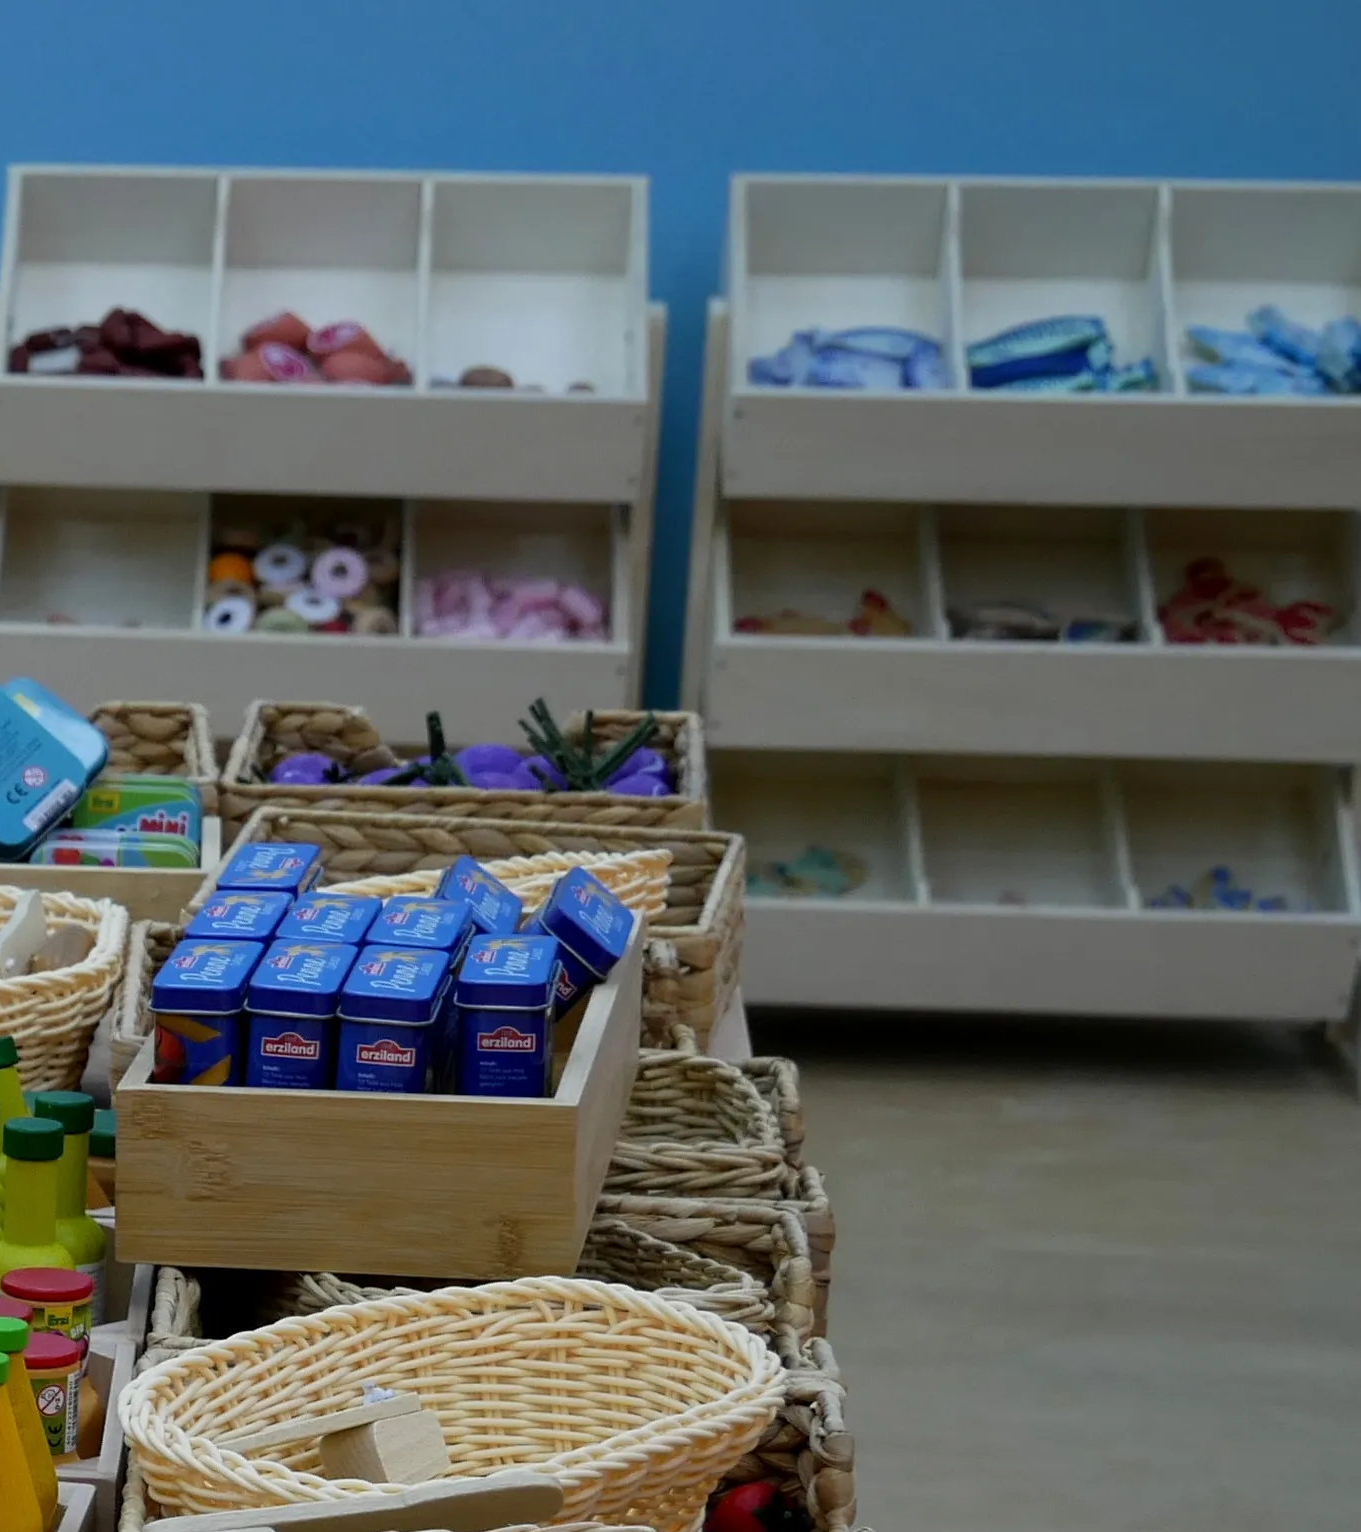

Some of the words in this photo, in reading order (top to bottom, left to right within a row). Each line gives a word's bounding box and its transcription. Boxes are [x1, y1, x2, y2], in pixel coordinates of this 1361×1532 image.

[211, 904, 262, 931] Penne
[301, 908, 352, 937] Penne
[394, 910, 442, 941] Penne
[179, 955, 231, 983] Penne
[276, 957, 328, 986] Penne
[370, 960, 419, 993] Penne
[484, 950, 531, 979] Penne
[265, 1042, 315, 1055] erziland
[361, 1049, 411, 1063] erziland
[480, 1036, 532, 1048] erziland
[48, 1313, 70, 1326] Erzi
